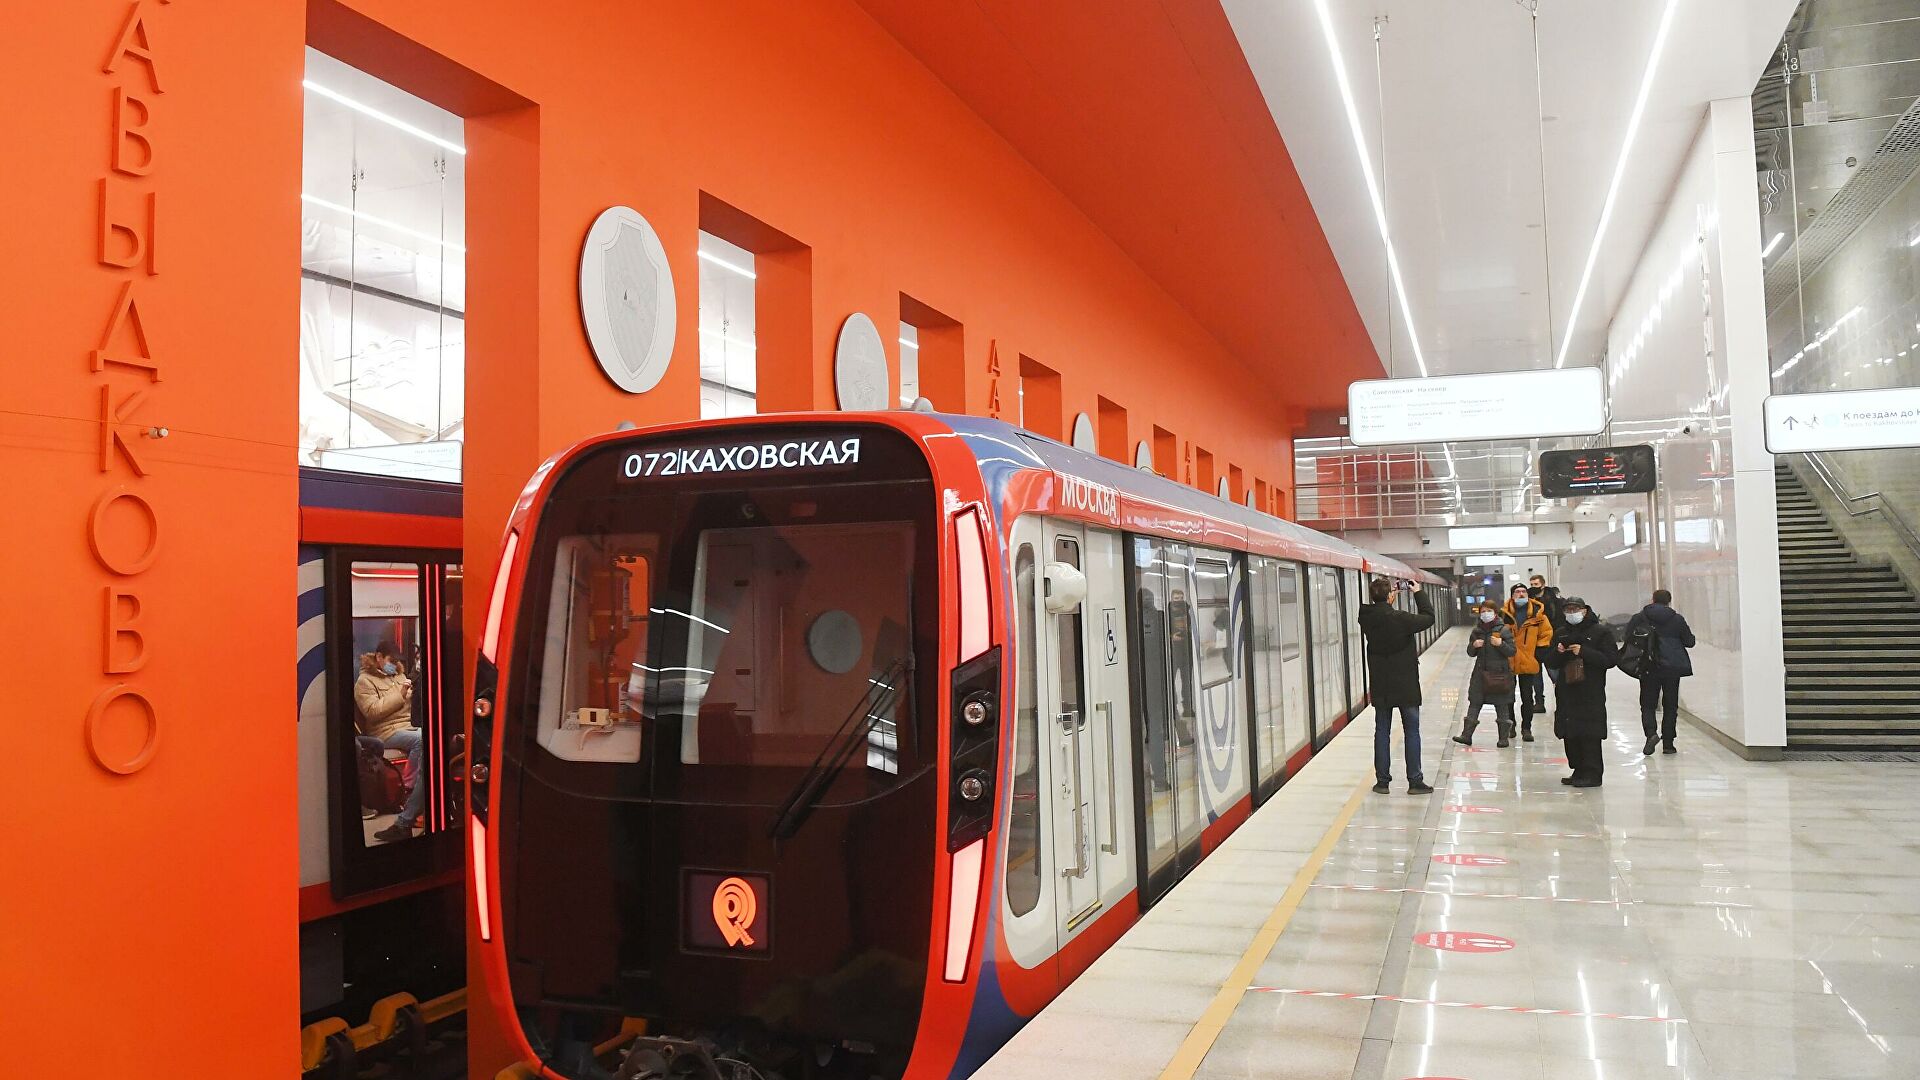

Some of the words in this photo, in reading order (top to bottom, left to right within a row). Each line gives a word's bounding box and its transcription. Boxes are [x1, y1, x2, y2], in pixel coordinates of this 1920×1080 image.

[86, 0, 168, 776] АВЫДКОВО
[1843, 412, 1851, 420] К
[1853, 411, 1898, 420] поездам
[1900, 410, 1914, 419] до
[1061, 476, 1118, 518] МОСКВА
